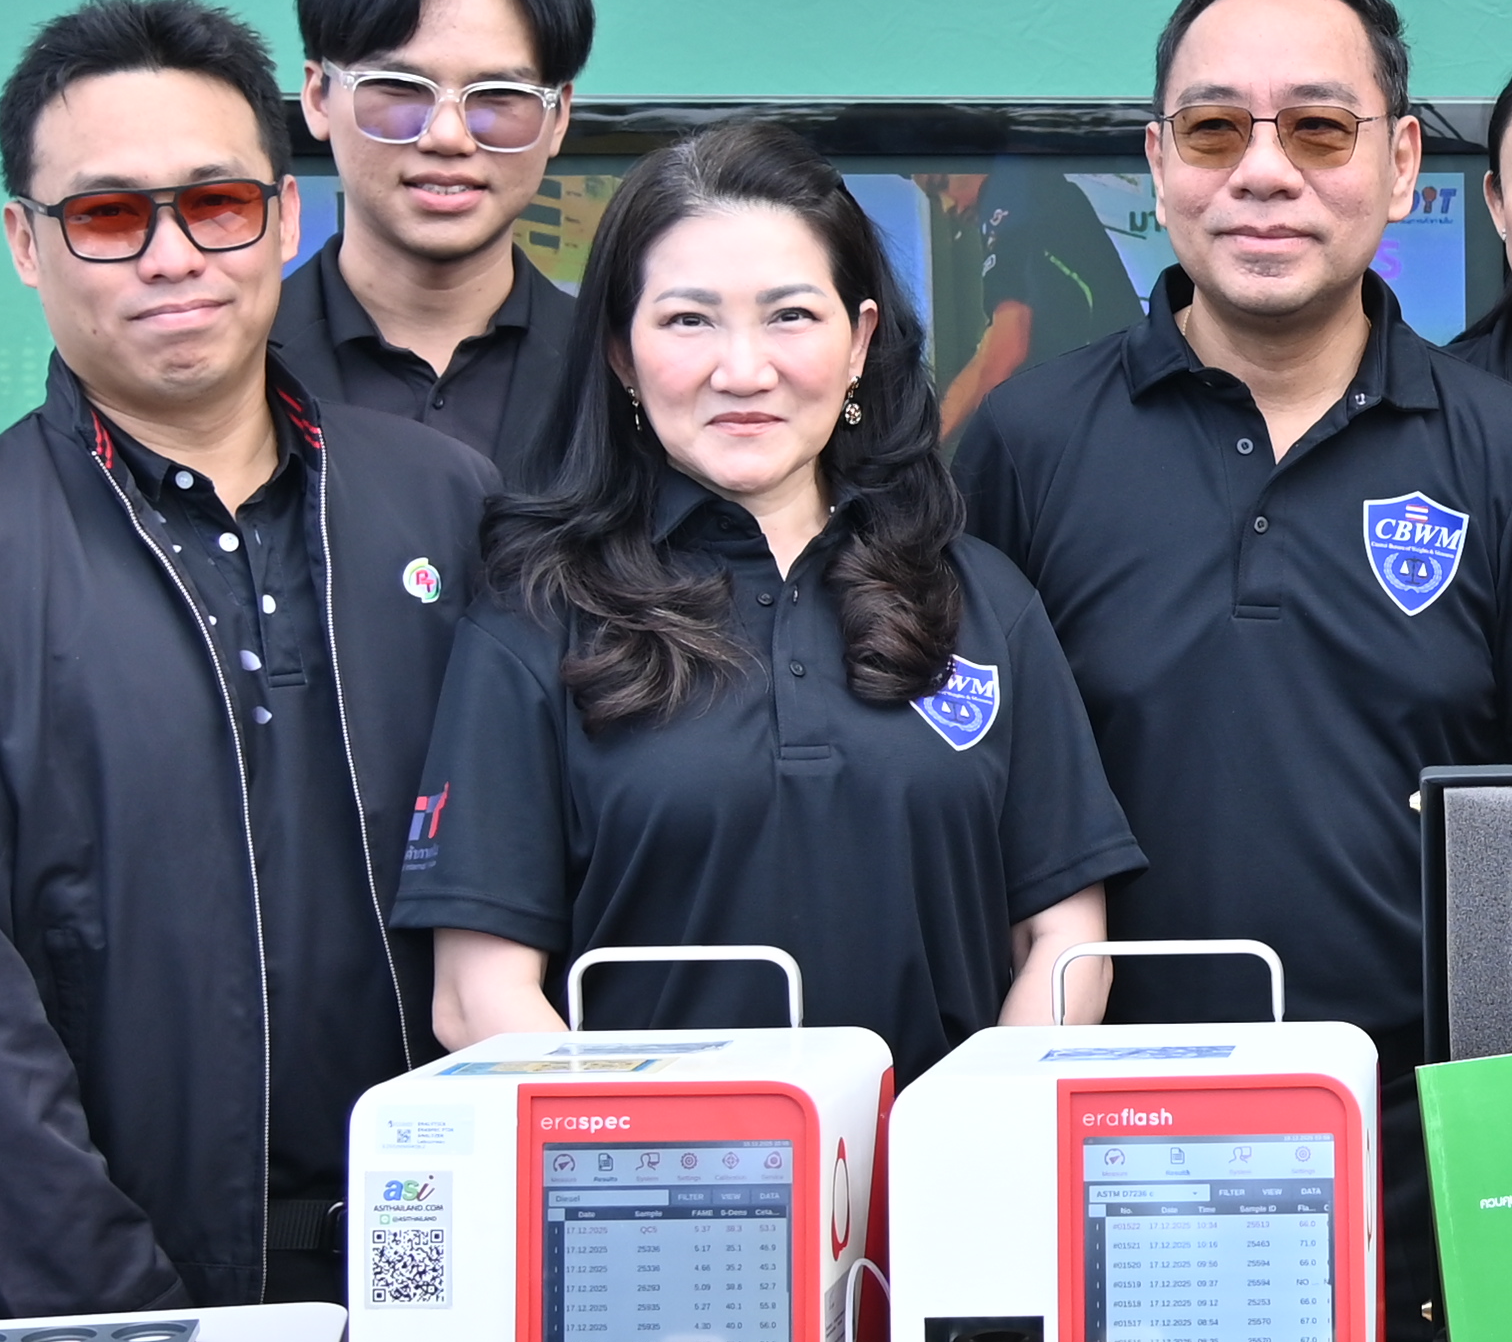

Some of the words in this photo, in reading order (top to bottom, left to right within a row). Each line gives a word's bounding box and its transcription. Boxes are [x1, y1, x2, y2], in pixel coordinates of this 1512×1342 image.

[1375, 518, 1463, 550] CBWM
[946, 676, 995, 698] WM
[540, 1115, 631, 1134] eraspec
[1083, 1108, 1173, 1126] eraflash
[760, 1192, 780, 1200] DATA
[1301, 1188, 1321, 1196] DATA
